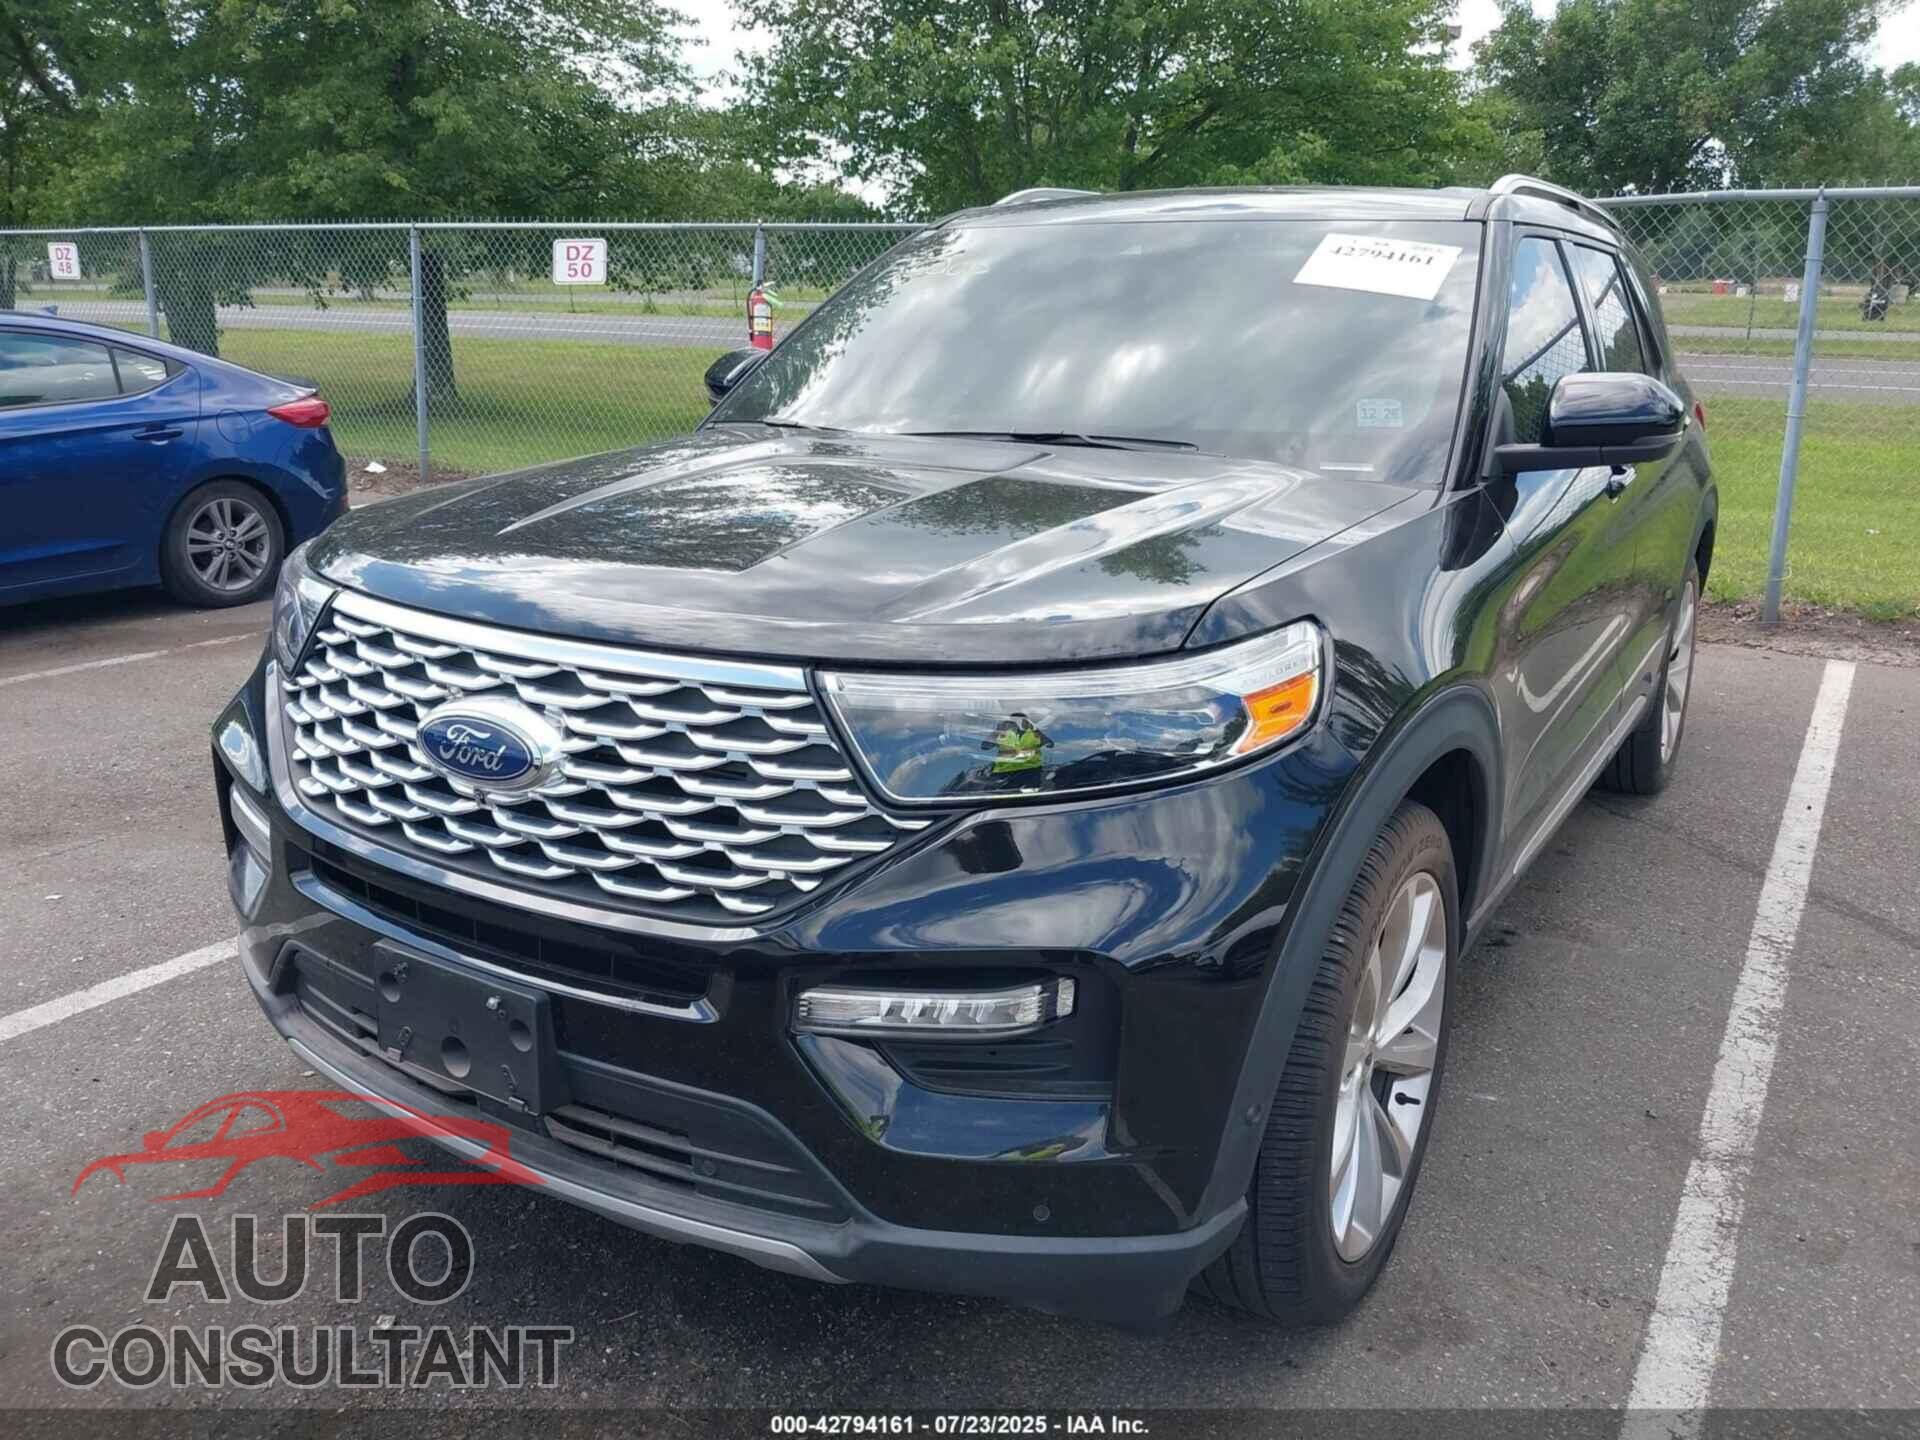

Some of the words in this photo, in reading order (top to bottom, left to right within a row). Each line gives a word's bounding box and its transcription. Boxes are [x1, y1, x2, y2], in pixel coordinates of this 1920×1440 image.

[56, 247, 72, 260] DZ
[565, 245, 594, 261] DZ
[58, 262, 72, 274] 48
[567, 262, 592, 278] 50
[440, 724, 507, 772] Ford
